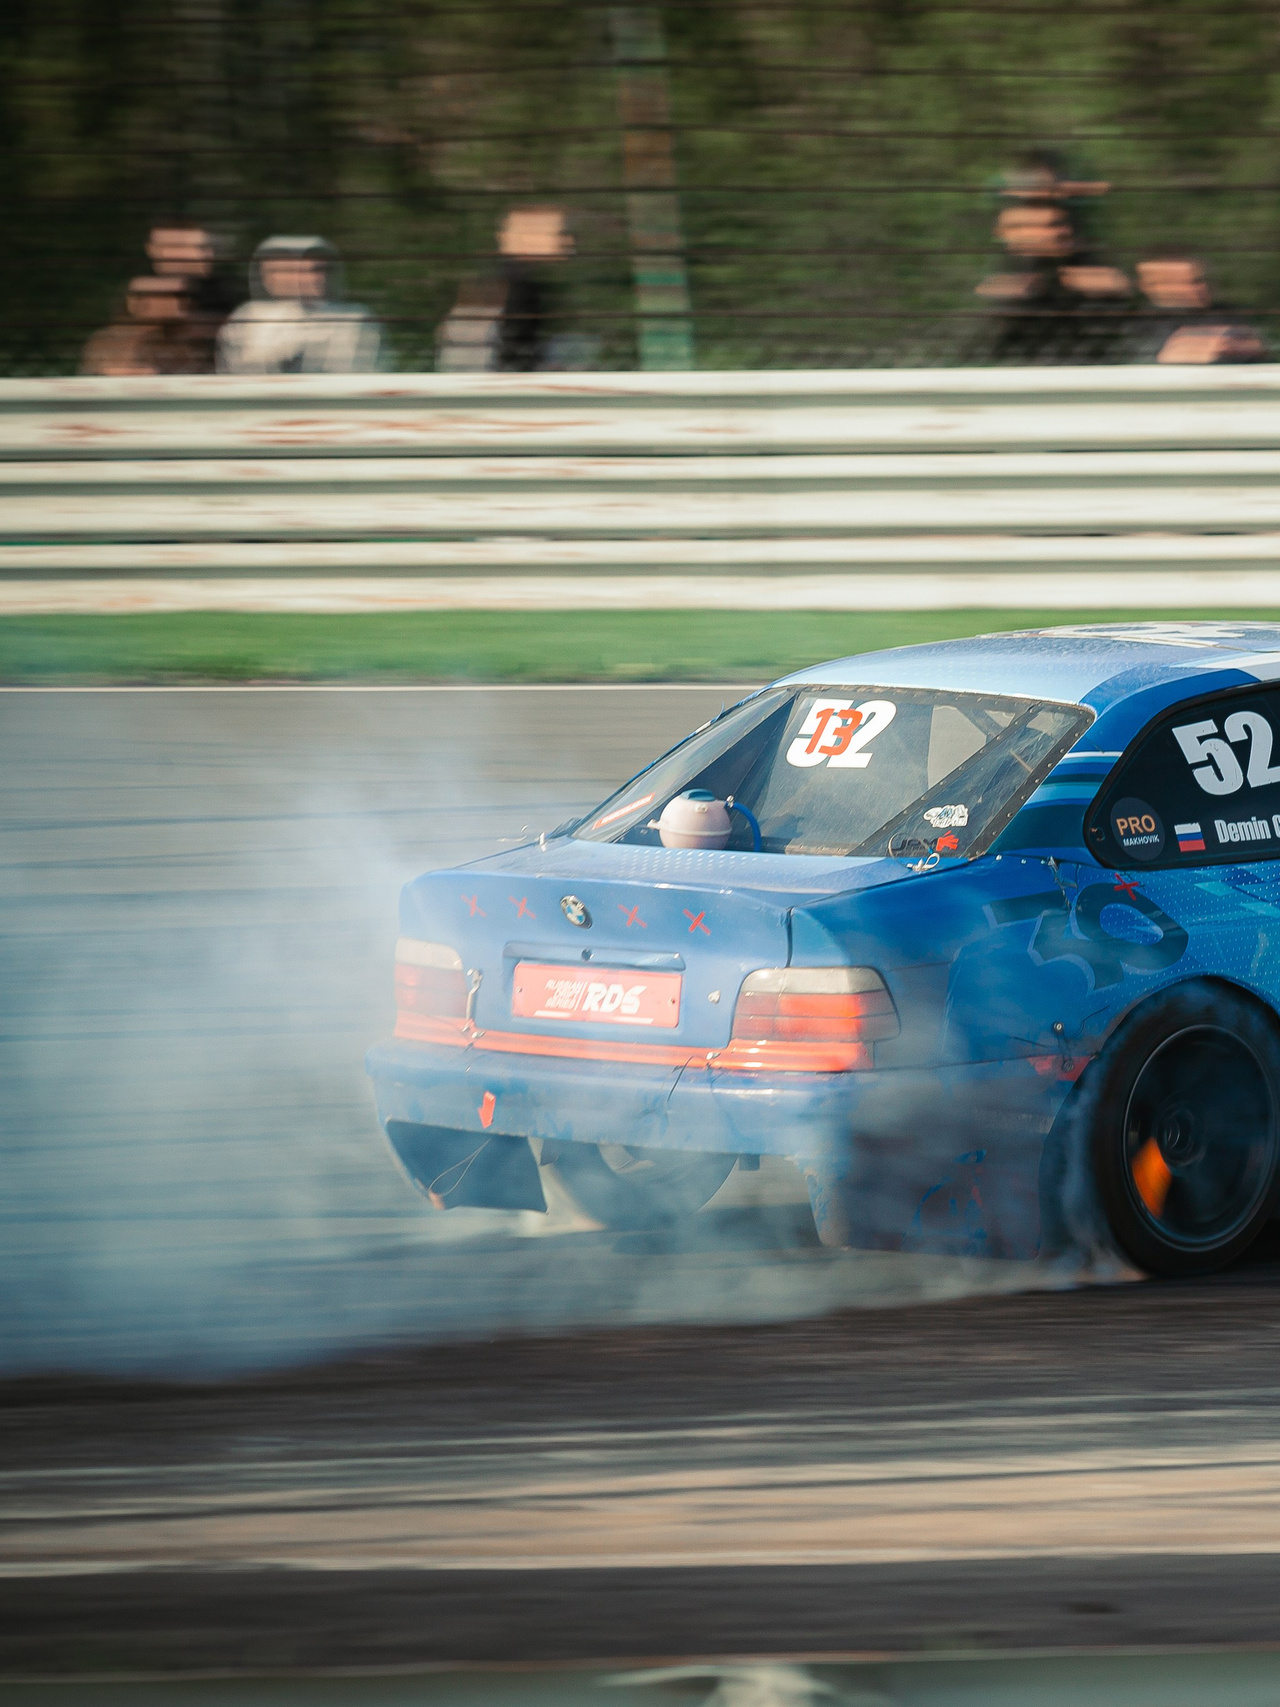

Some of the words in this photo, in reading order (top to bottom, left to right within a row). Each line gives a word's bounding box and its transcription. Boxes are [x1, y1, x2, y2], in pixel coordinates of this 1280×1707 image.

[786, 698, 897, 768] 52
[804, 708, 864, 756] 13
[1116, 814, 1156, 836] PRO
[1214, 816, 1272, 844] Demin
[1123, 834, 1160, 847] MAKHOVIK
[581, 983, 648, 1015] RDS
